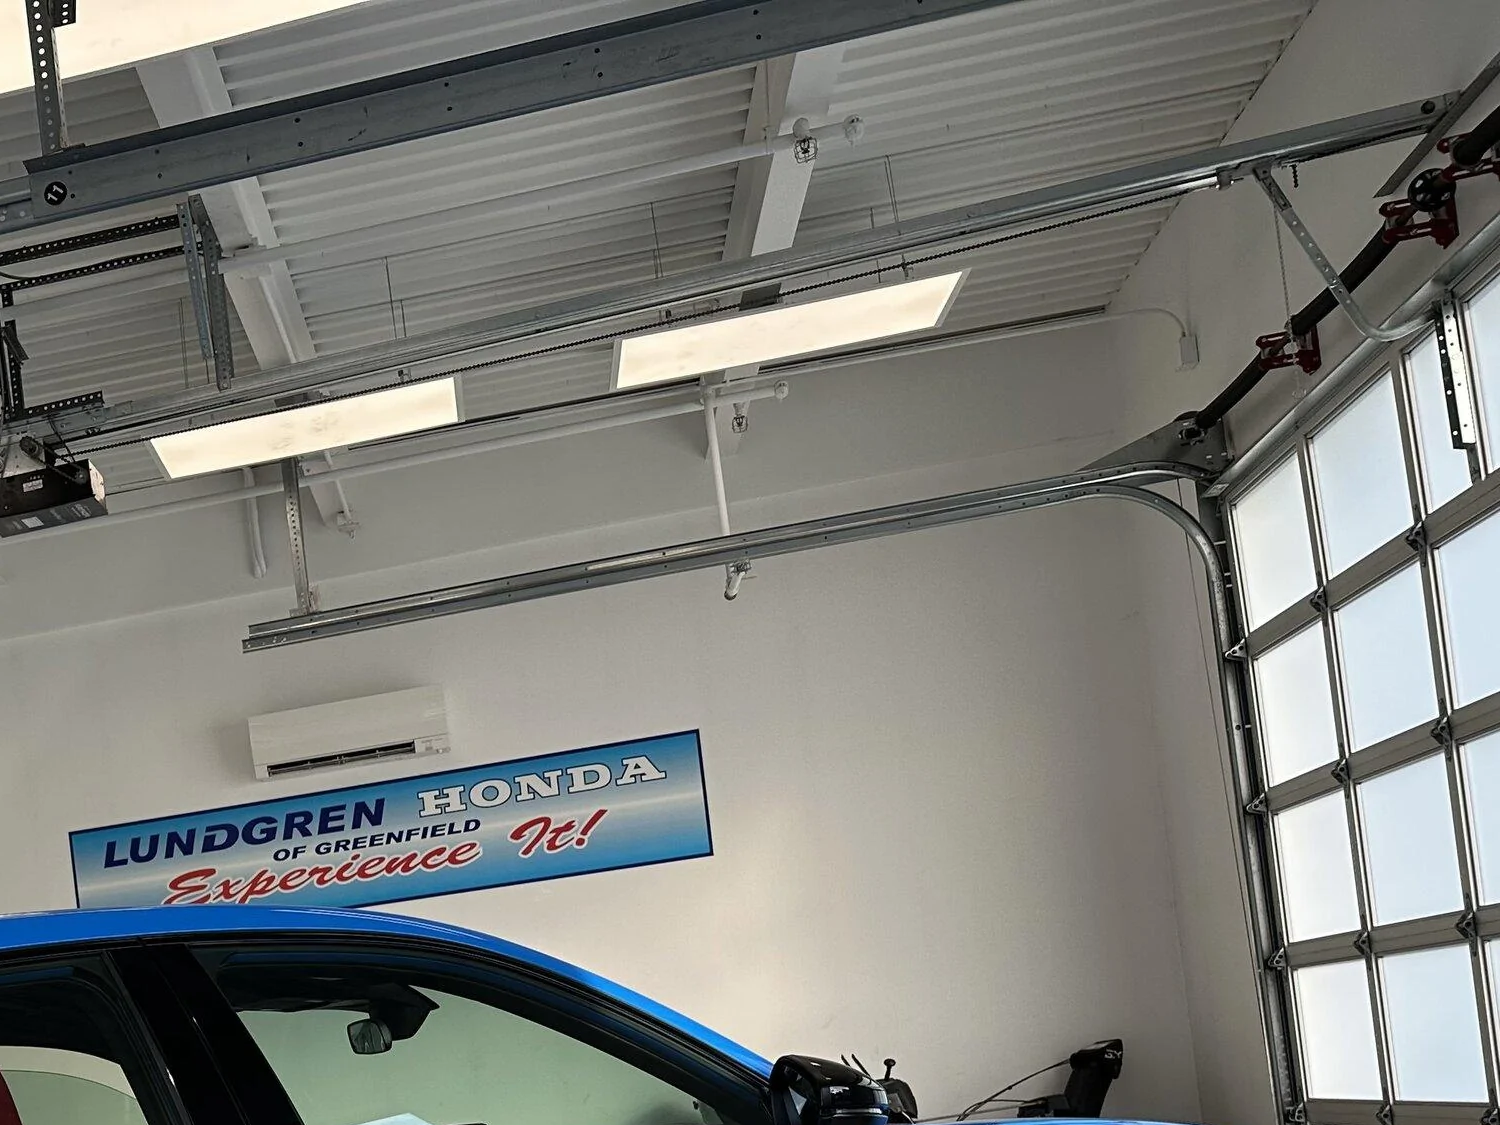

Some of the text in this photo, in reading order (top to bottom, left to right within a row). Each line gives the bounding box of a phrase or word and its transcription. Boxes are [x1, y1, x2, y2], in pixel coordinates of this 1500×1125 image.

[47, 184, 64, 201] 11
[103, 755, 667, 869] LUNDGREN HONDA
[272, 818, 481, 862] OF GREENFIELD
[162, 808, 609, 905] Experience It!
